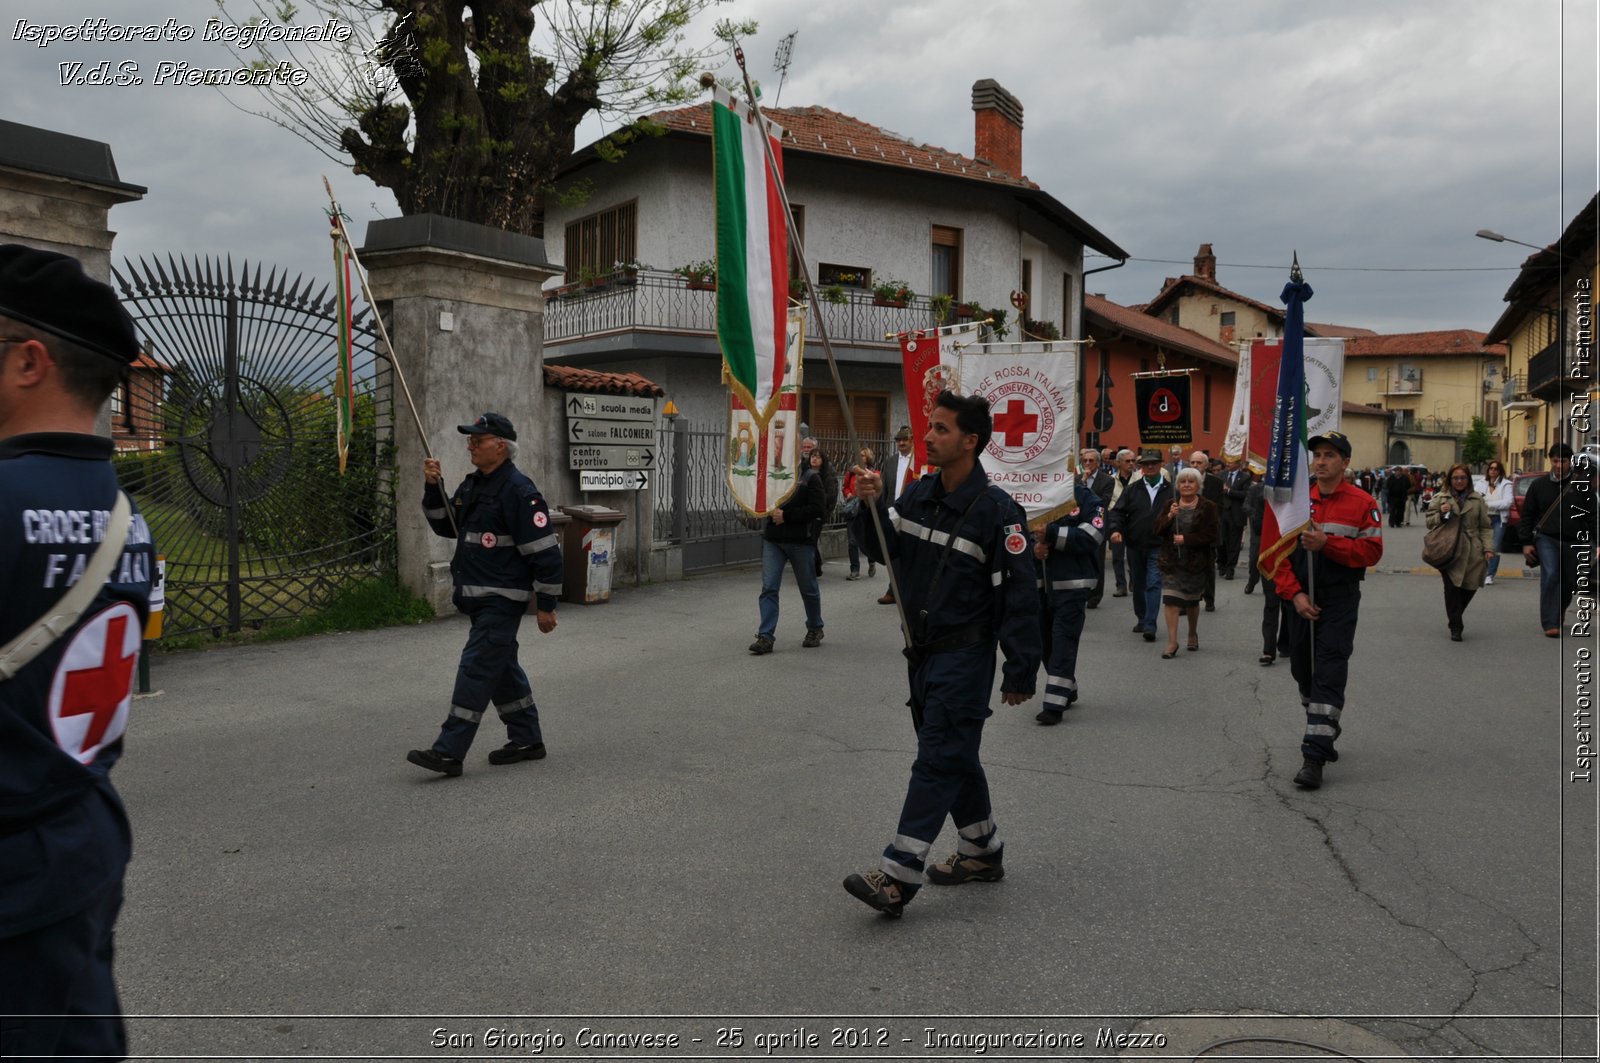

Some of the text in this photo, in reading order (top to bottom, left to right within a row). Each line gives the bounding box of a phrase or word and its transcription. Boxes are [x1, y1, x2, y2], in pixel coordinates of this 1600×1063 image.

[994, 366, 1031, 381] ROSSA
[1034, 370, 1068, 413] ITALIANA
[998, 383, 1034, 396] GINEVRA
[1034, 392, 1044, 404] 22
[601, 404, 652, 415] scuola media
[1040, 406, 1053, 443] AGOSTO
[1307, 402, 1337, 434] ANAVESE
[588, 427, 653, 439] salone FALCONIERI
[572, 448, 601, 456] centro
[1024, 445, 1043, 459] 1864
[572, 457, 608, 468] sportivo
[581, 473, 624, 488] municipio
[986, 472, 1065, 483] EGAZIONE DI
[22, 509, 92, 544] CROCE
